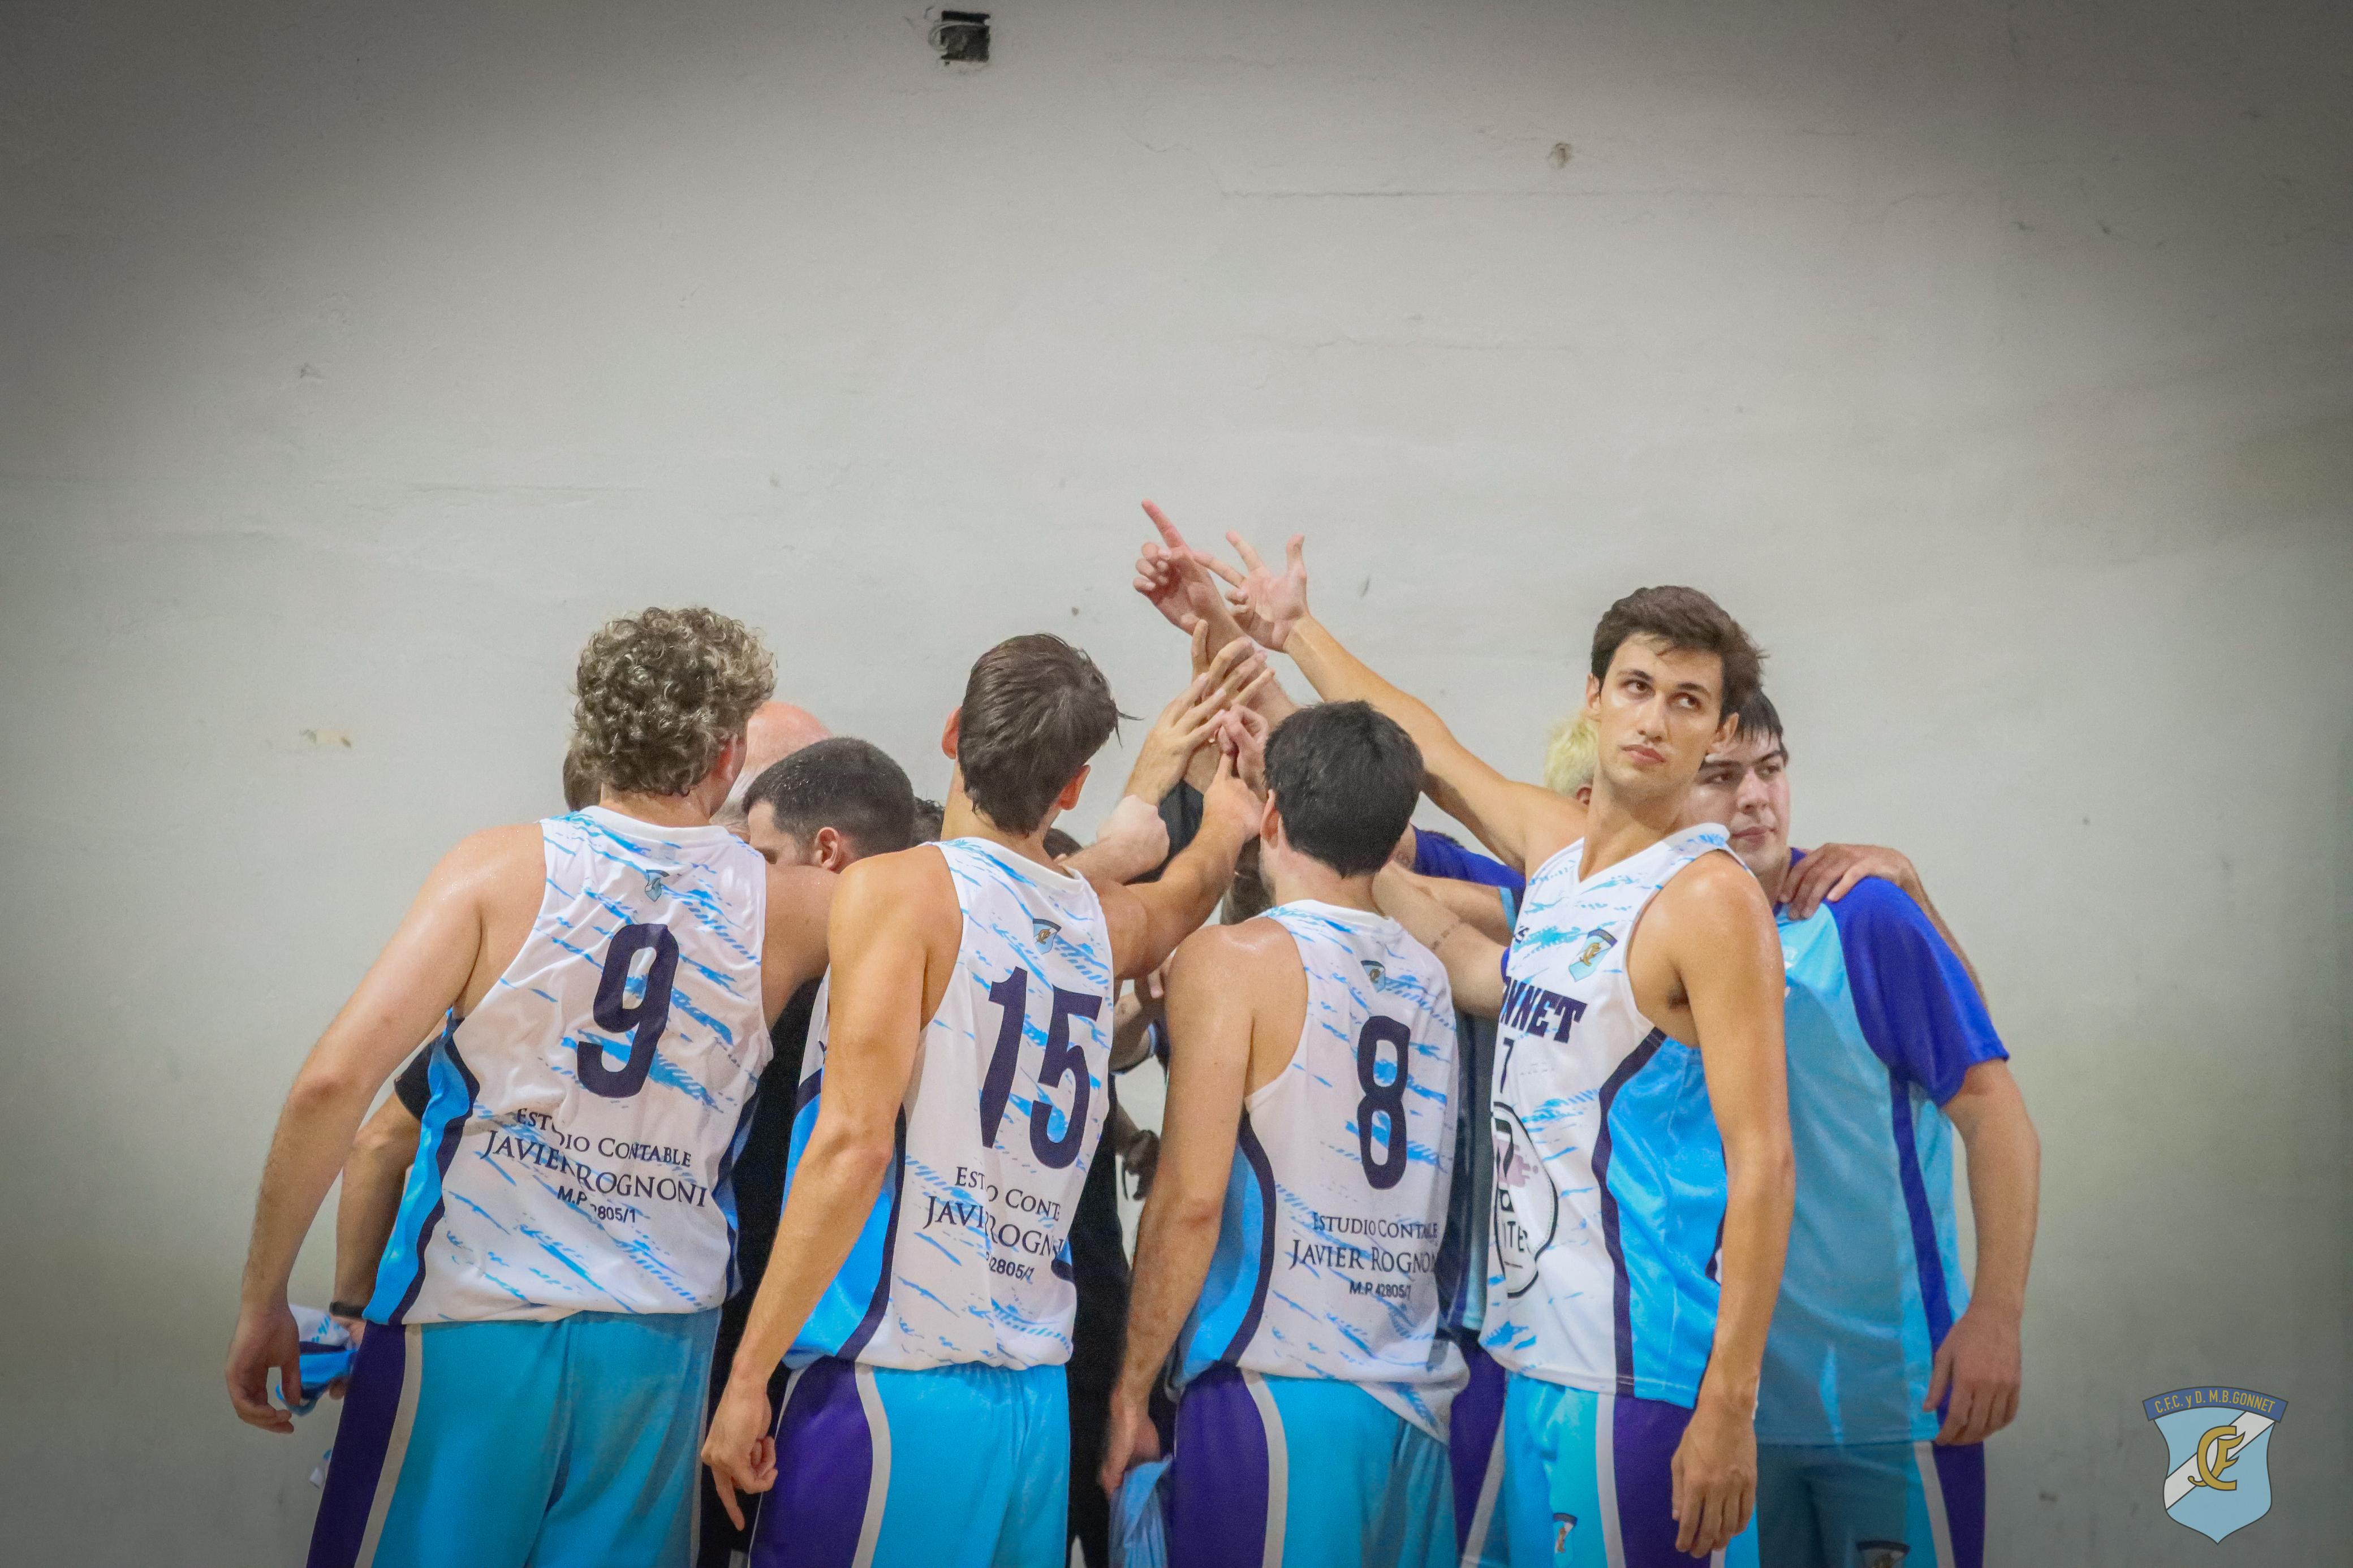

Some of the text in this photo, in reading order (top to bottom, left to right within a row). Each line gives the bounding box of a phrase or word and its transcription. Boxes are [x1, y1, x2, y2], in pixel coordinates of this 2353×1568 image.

[577, 923, 679, 1098] 9
[1500, 977, 1588, 1044] NNET
[980, 966, 1102, 1169] 15
[1358, 1016, 1411, 1190] 8
[598, 1138, 692, 1168] CONTABLE
[575, 1161, 708, 1208] ROGNONI
[590, 1203, 636, 1223] 805/1
[989, 1256, 1035, 1281] 2805/1
[1288, 1239, 1365, 1271] JAVIER
